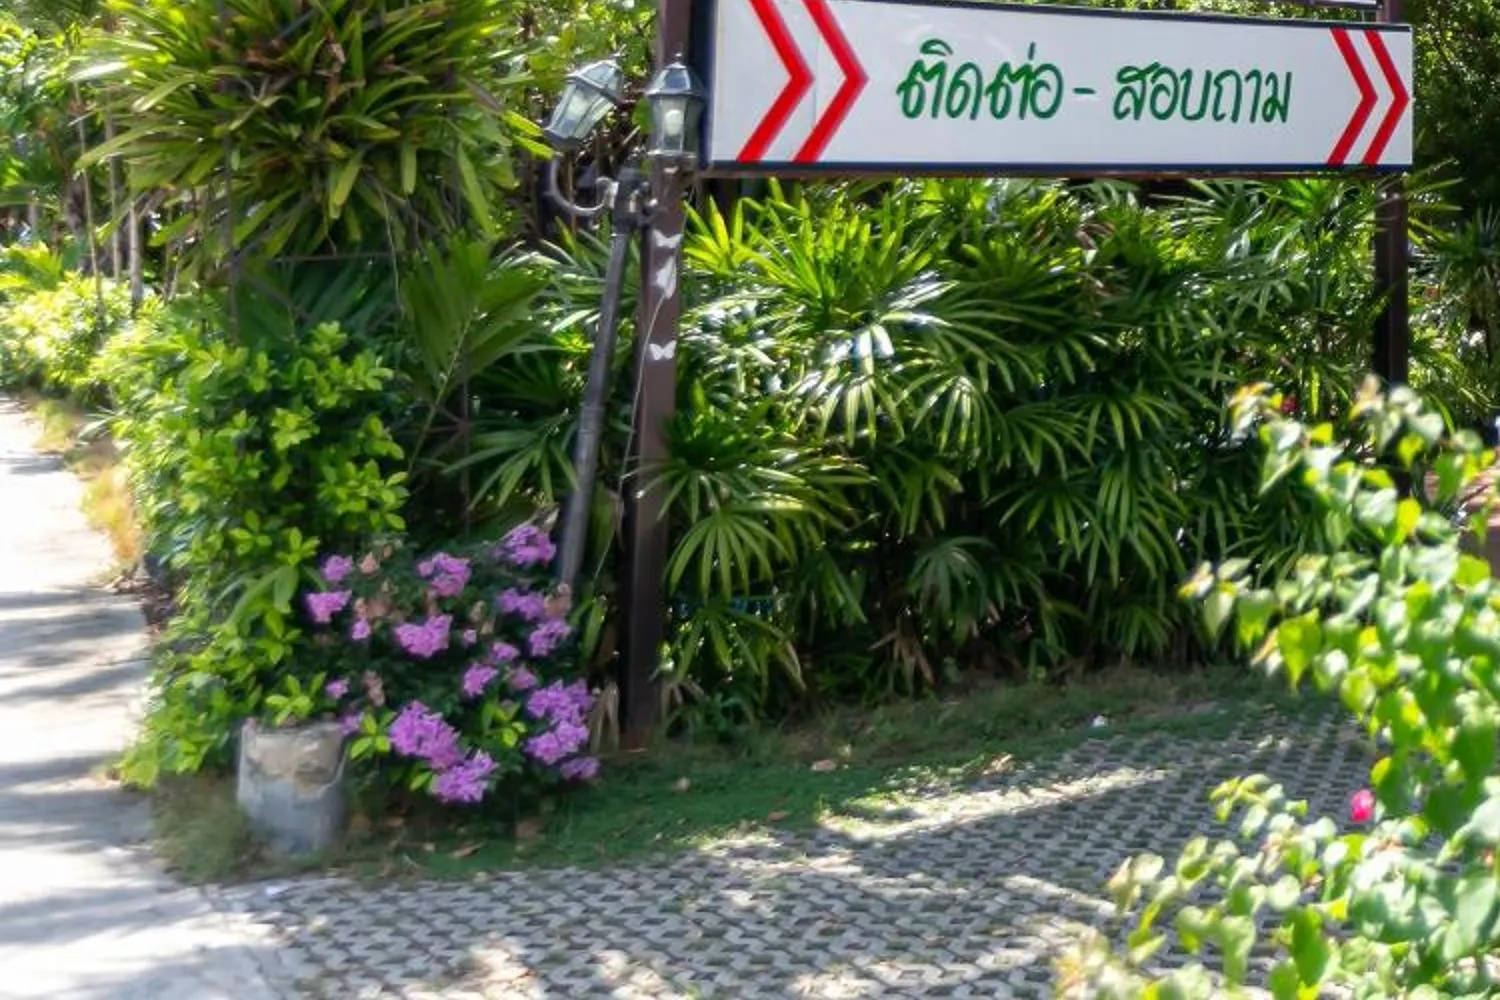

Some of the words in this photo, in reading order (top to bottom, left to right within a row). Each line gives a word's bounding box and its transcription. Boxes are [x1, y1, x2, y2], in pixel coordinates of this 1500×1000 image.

[896, 38, 1064, 121] ติดต่อ
[1112, 61, 1293, 124] สอบถาม
